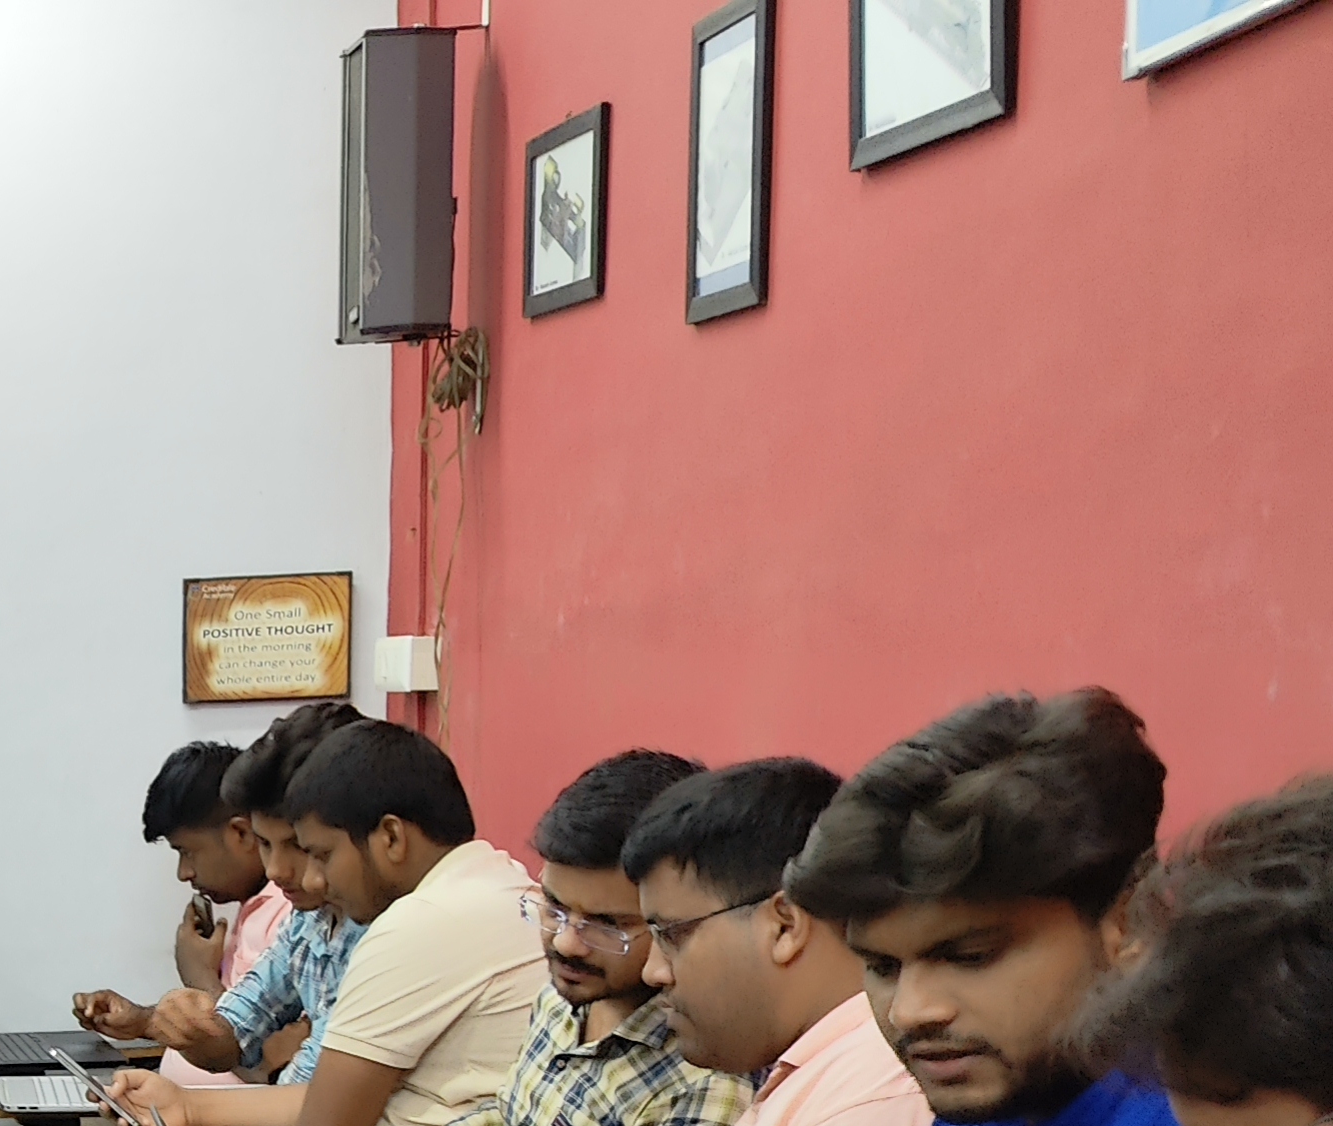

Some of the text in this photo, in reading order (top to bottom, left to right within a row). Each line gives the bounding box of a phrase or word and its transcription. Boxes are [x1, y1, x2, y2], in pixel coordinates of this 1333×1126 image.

[234, 607, 301, 621] One Small
[203, 623, 334, 639] POSITIVE THOUGHT
[223, 641, 312, 653] in the morning
[219, 657, 316, 670] can change your
[216, 673, 252, 685] whole
[256, 673, 291, 684] entire
